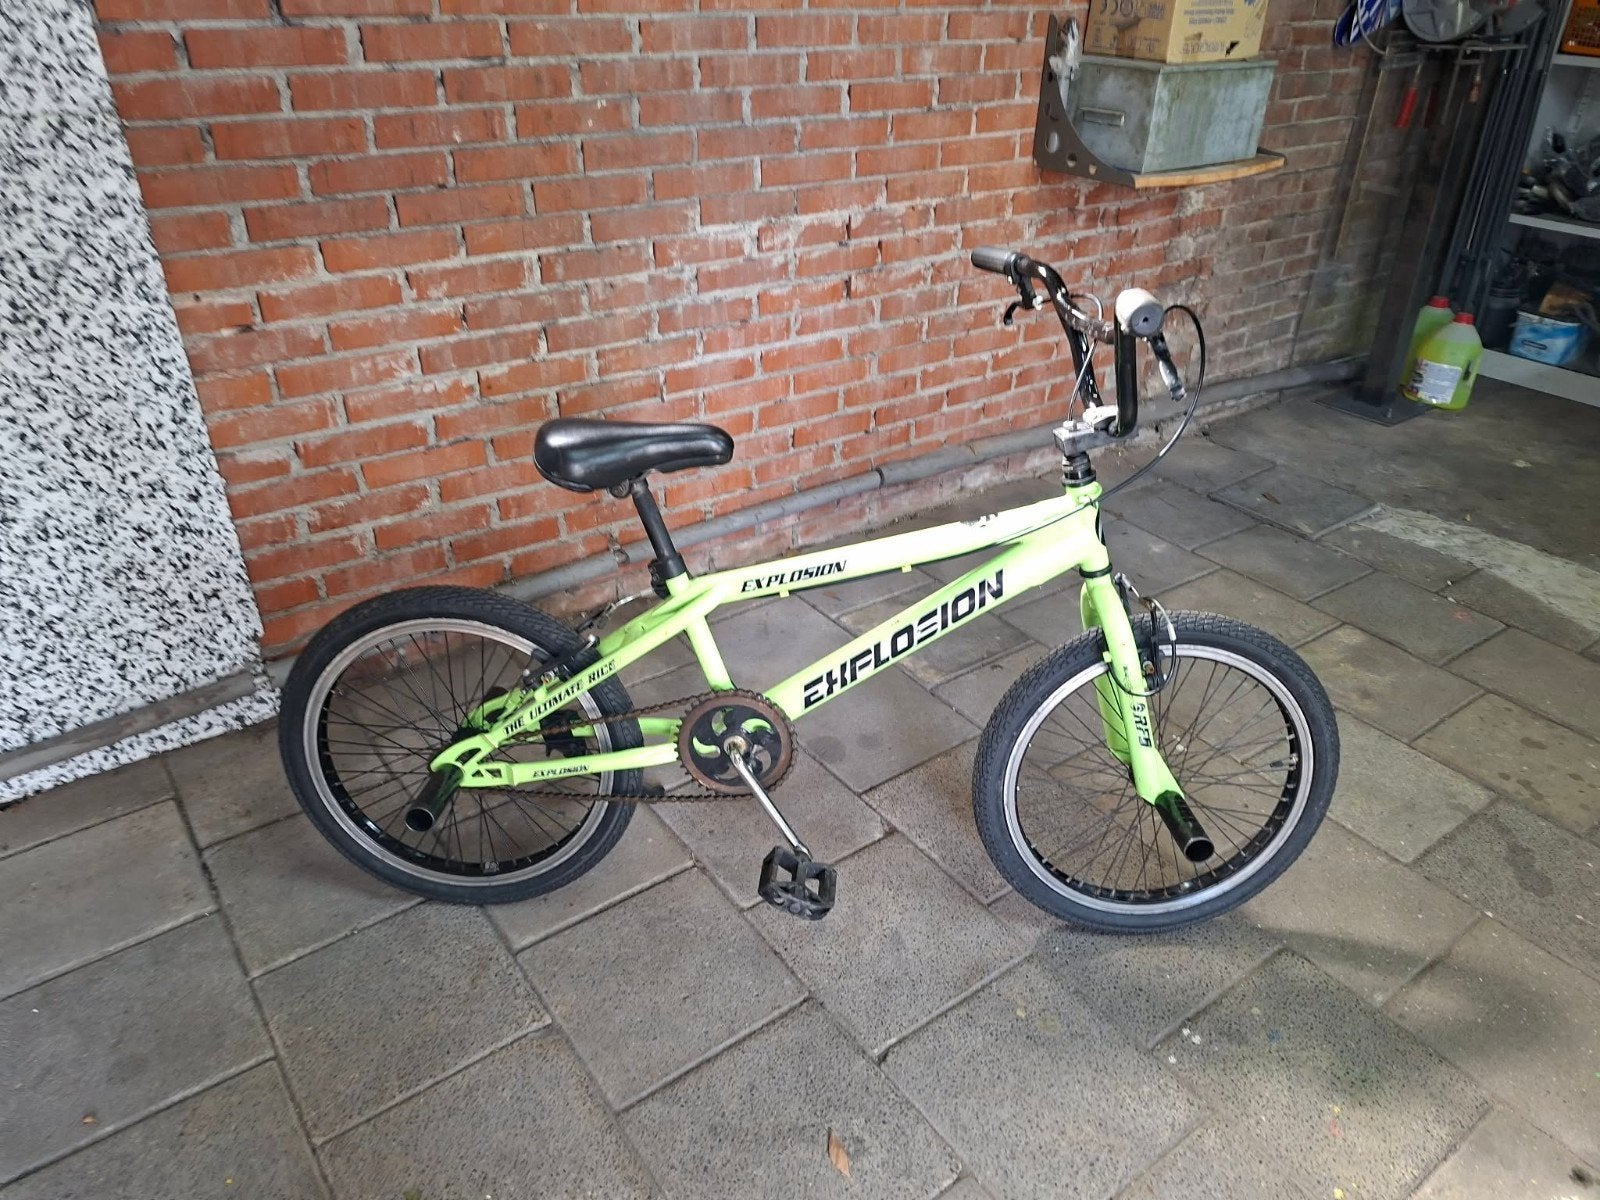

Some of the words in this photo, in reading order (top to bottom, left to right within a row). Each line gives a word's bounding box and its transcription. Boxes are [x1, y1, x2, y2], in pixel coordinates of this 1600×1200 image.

[741, 560, 847, 593] EXPLOSION
[803, 569, 1004, 709] EXPLOSION
[504, 716, 524, 734] THE
[529, 679, 584, 720] ULTIMATE
[533, 765, 589, 778] EXPLOSION
